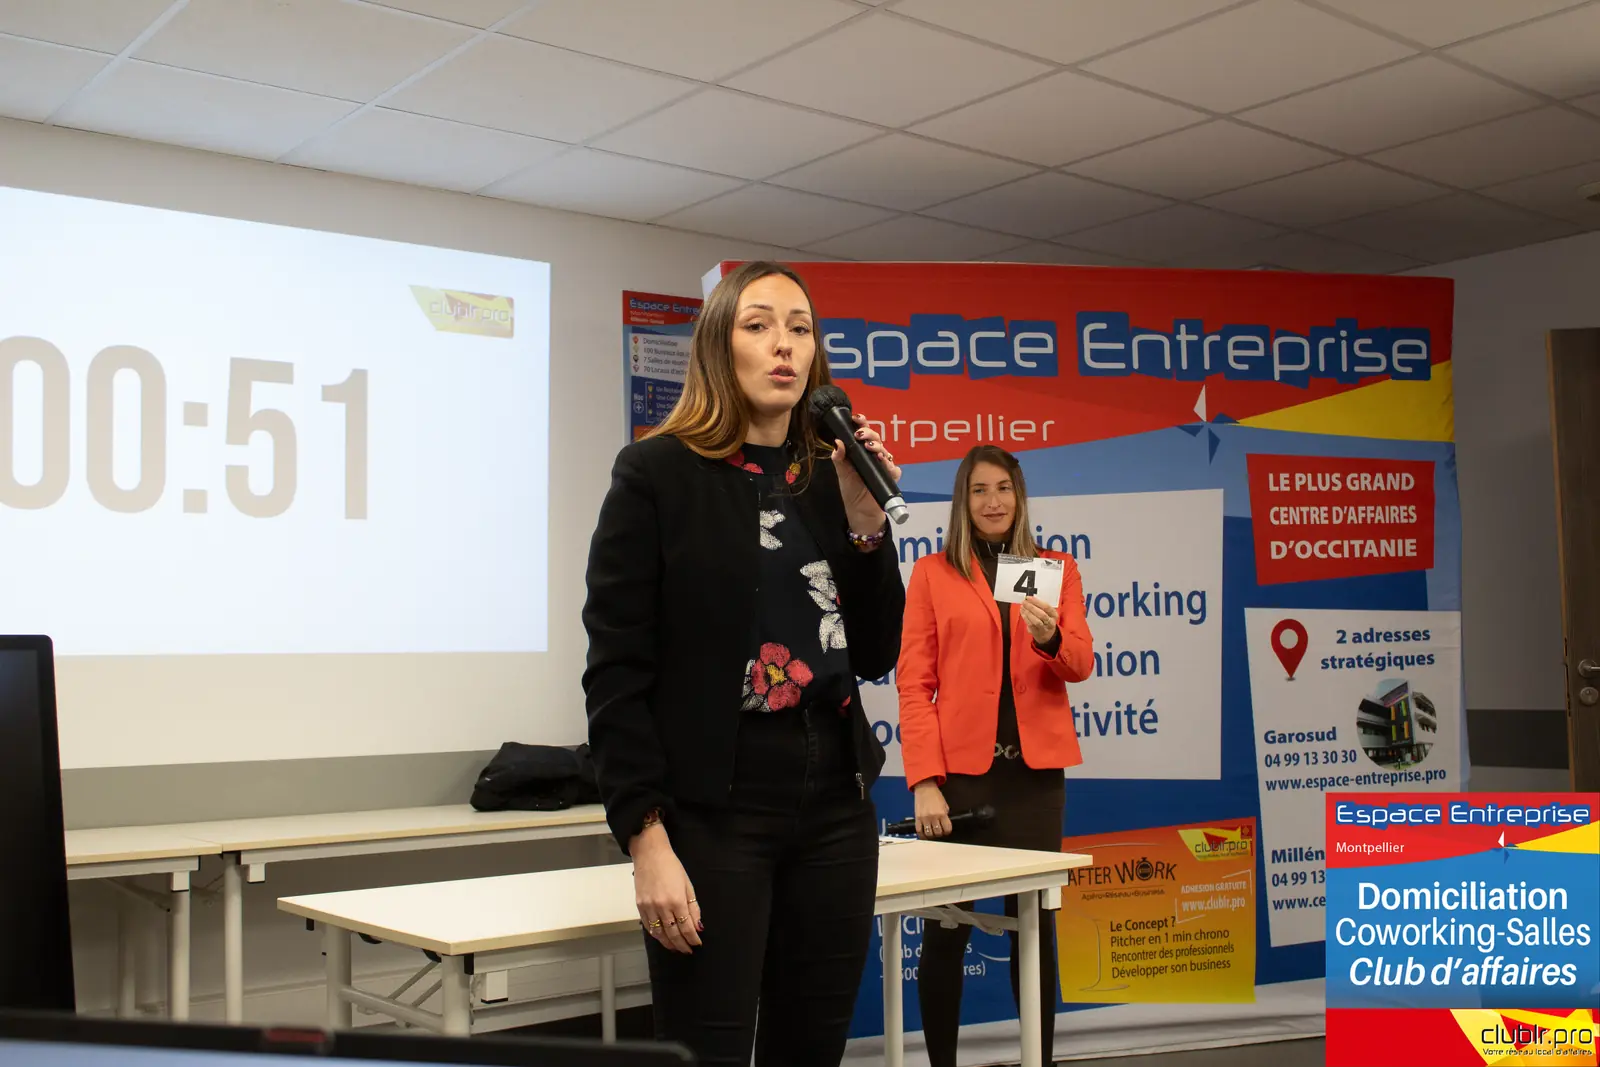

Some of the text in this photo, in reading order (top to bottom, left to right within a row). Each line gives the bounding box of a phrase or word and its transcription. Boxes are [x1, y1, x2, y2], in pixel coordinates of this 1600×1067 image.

[629, 298, 700, 316] Espace Entre
[822, 322, 1428, 380] space Entreprise
[0, 334, 369, 520] 00:51
[868, 414, 1055, 448] ntpellier
[1268, 472, 1415, 491] LE PLUS GRAND
[1269, 505, 1417, 525] CENTRE D'AFFAIRES
[1270, 539, 1417, 560] D'OCCITANIE
[1013, 569, 1038, 597] 4
[1336, 627, 1431, 644] 2 adresses
[1320, 651, 1435, 671] stratégiques
[1070, 699, 1158, 738] tivité
[1263, 727, 1337, 745] Garosud
[1264, 749, 1357, 768] 04 99 13 30 30
[1265, 767, 1447, 791] www.espace-entreprise.pro
[1271, 847, 1325, 864] Millén
[1068, 866, 1112, 887] AFTER
[1271, 869, 1325, 888] 04 99 13
[1272, 896, 1326, 910] www.ce
[1109, 920, 1122, 933] Le
[1125, 917, 1168, 932] Concept
[1110, 928, 1230, 948] Pitcher en 1 min chrono
[1111, 942, 1235, 963] Rencontrer des professionnels
[1112, 958, 1231, 979] Développer son business
